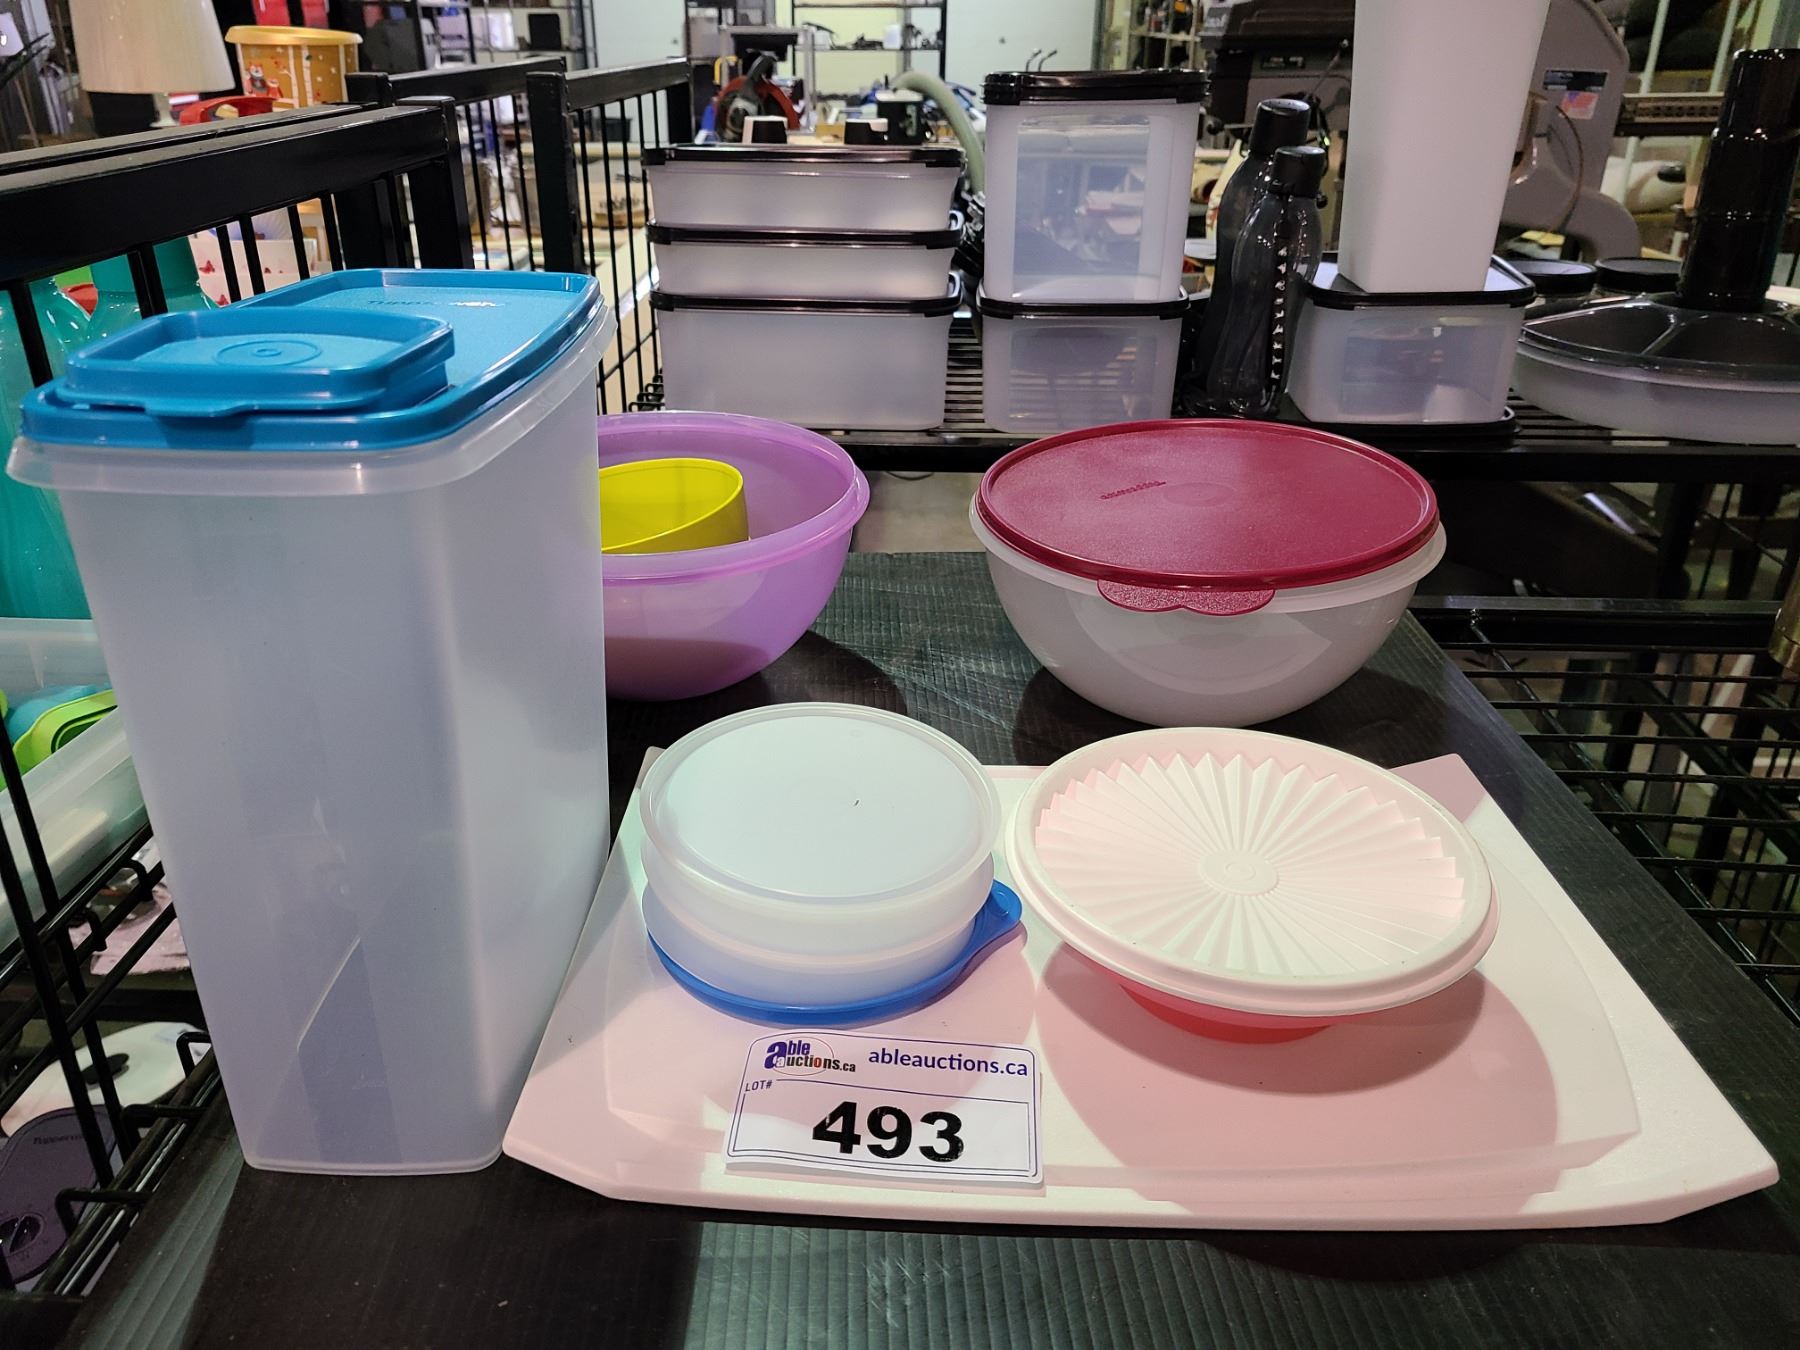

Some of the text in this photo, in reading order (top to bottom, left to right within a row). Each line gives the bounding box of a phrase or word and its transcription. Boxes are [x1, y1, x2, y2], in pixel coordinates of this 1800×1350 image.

[868, 1047, 1028, 1076] ableauctions.ca
[745, 1079, 773, 1092] LOT#
[812, 1101, 965, 1163] 493
